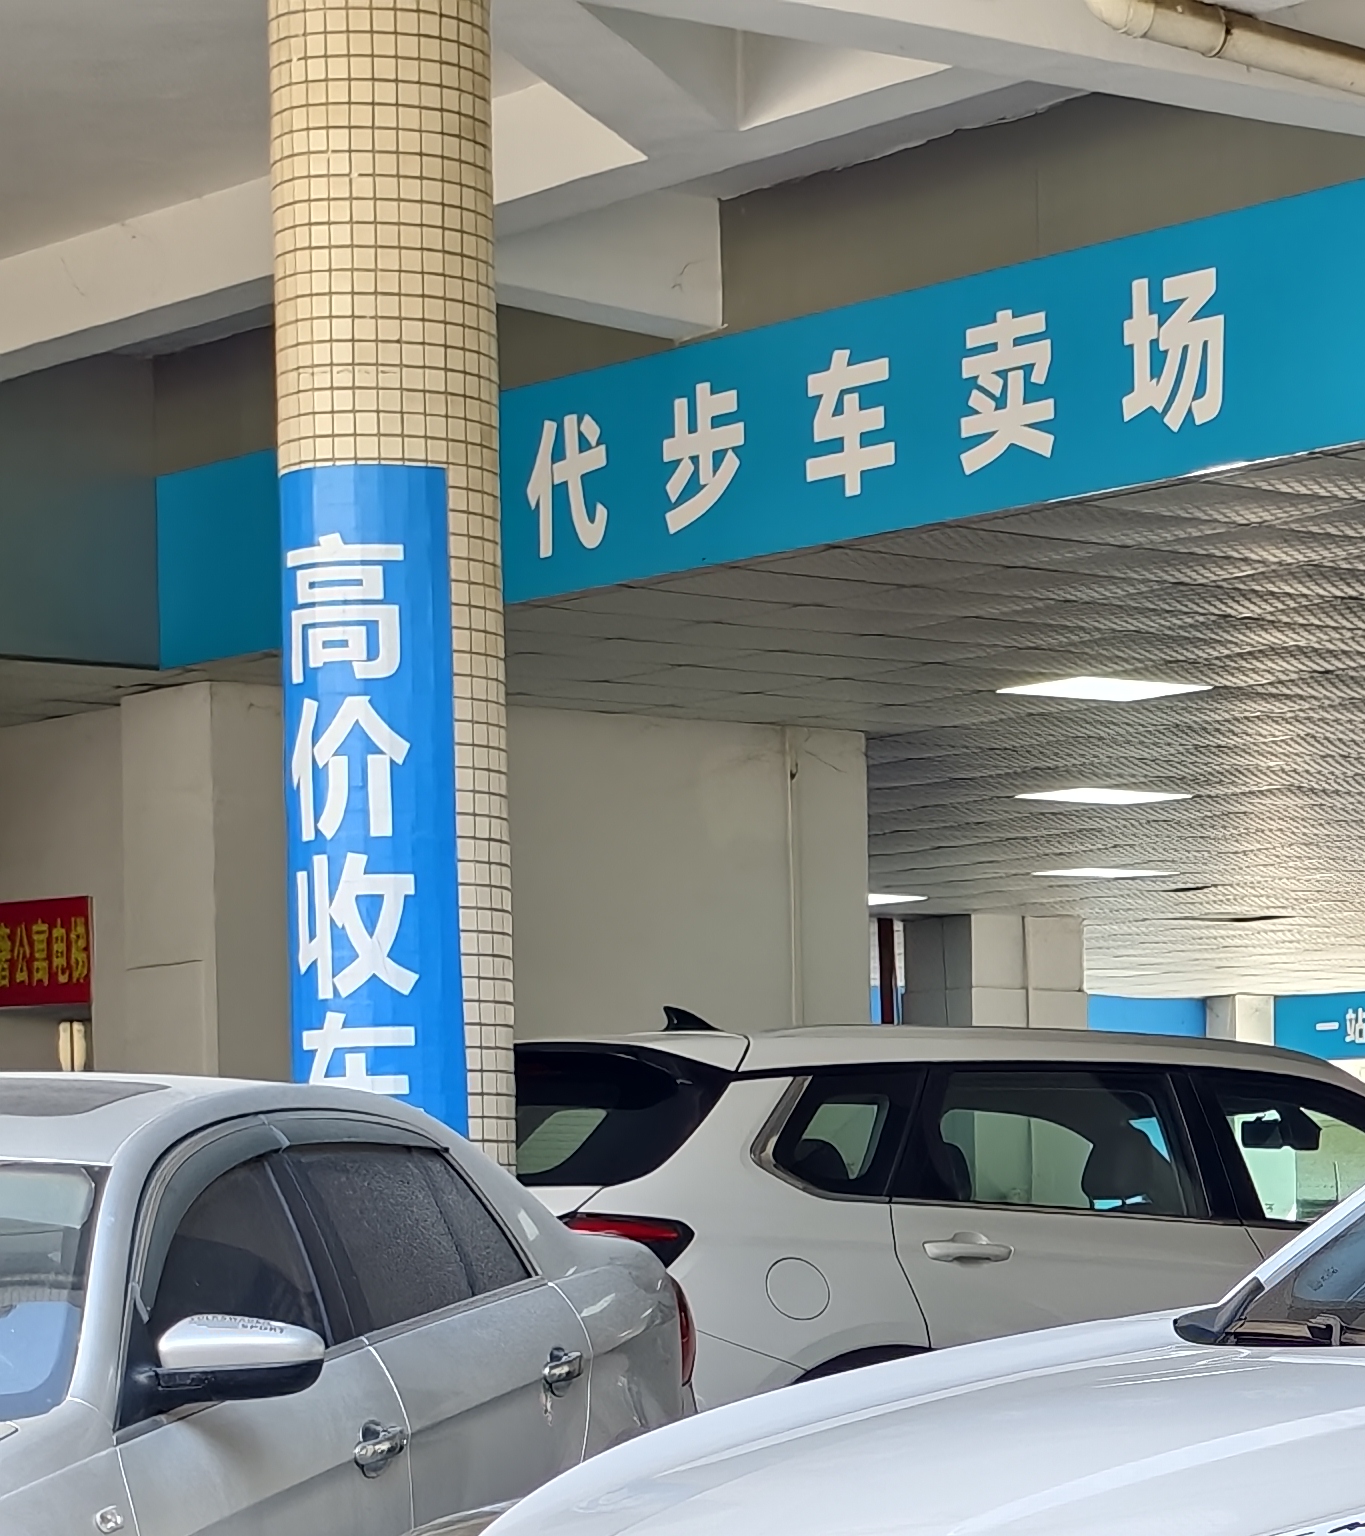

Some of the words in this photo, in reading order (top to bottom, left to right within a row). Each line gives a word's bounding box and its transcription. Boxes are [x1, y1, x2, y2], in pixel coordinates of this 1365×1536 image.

[526, 266, 1225, 560] 代步车卖场
[286, 532, 421, 1095] 高价收车
